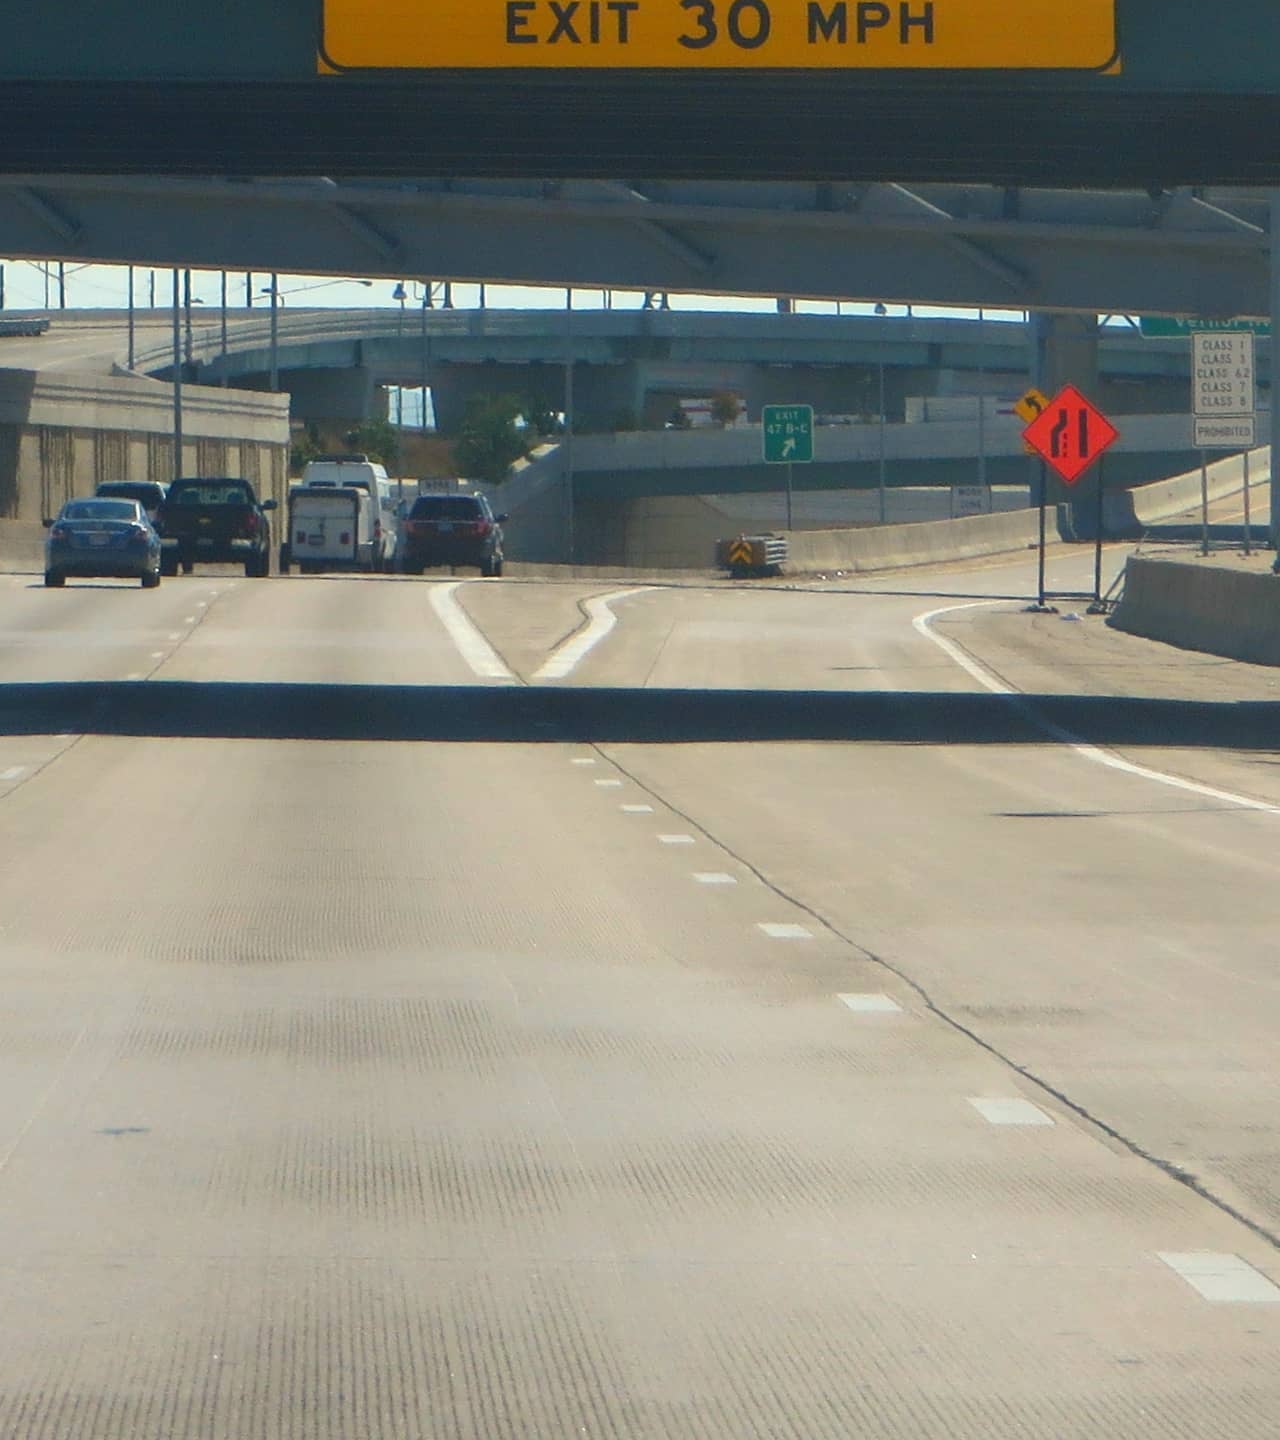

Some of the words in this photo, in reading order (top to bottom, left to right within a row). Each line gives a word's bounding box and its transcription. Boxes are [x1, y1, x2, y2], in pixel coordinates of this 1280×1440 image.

[505, 0, 640, 44] EXIT
[807, 0, 935, 44] MPH
[1202, 340, 1233, 351] CLASS
[1201, 354, 1232, 364] CLASS
[1197, 368, 1228, 378] CLASS
[1201, 382, 1232, 392] CLASS
[1201, 396, 1233, 406] CLASS
[775, 411, 798, 420] EXIT
[1198, 426, 1251, 437] PROHIBITED
